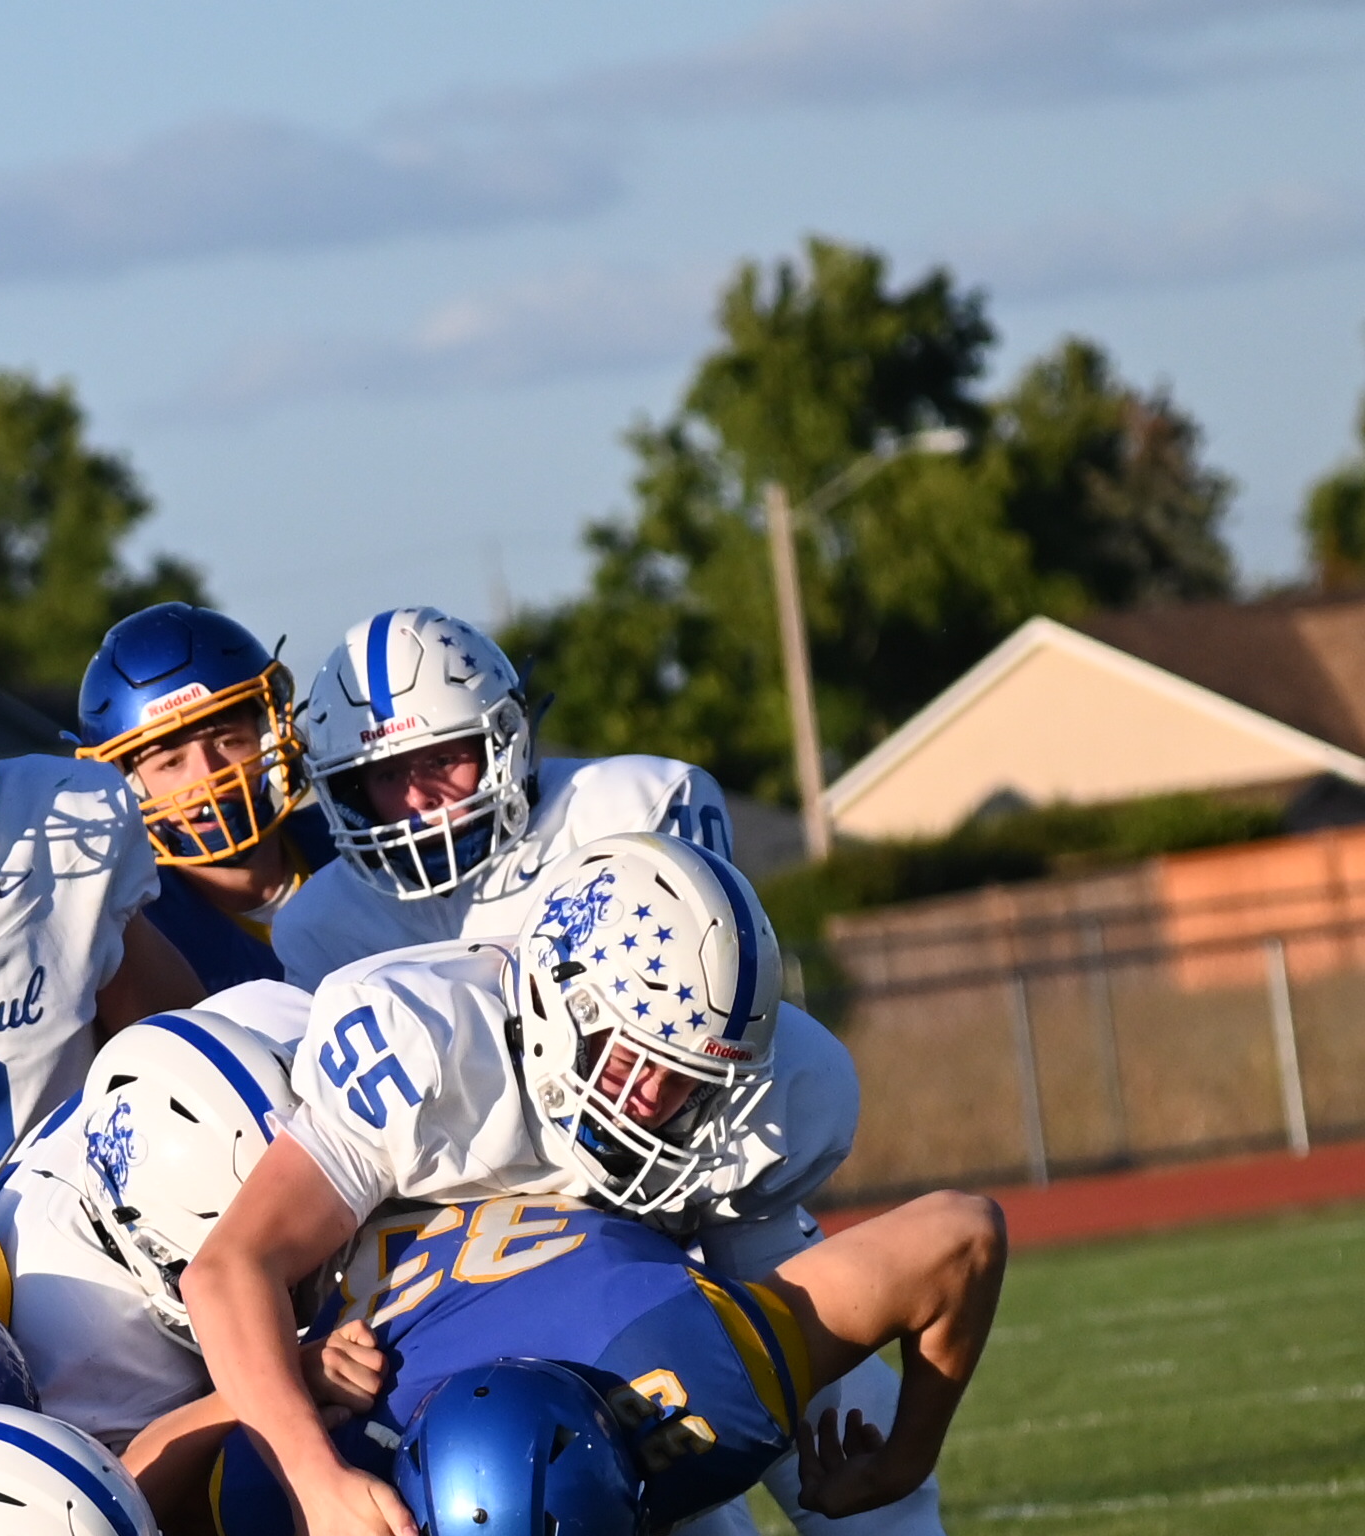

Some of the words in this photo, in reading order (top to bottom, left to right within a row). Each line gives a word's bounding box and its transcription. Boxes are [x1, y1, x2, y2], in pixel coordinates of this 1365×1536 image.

[148, 686, 203, 717] Riddell
[360, 716, 416, 743] Riddell
[319, 1005, 423, 1130] 55
